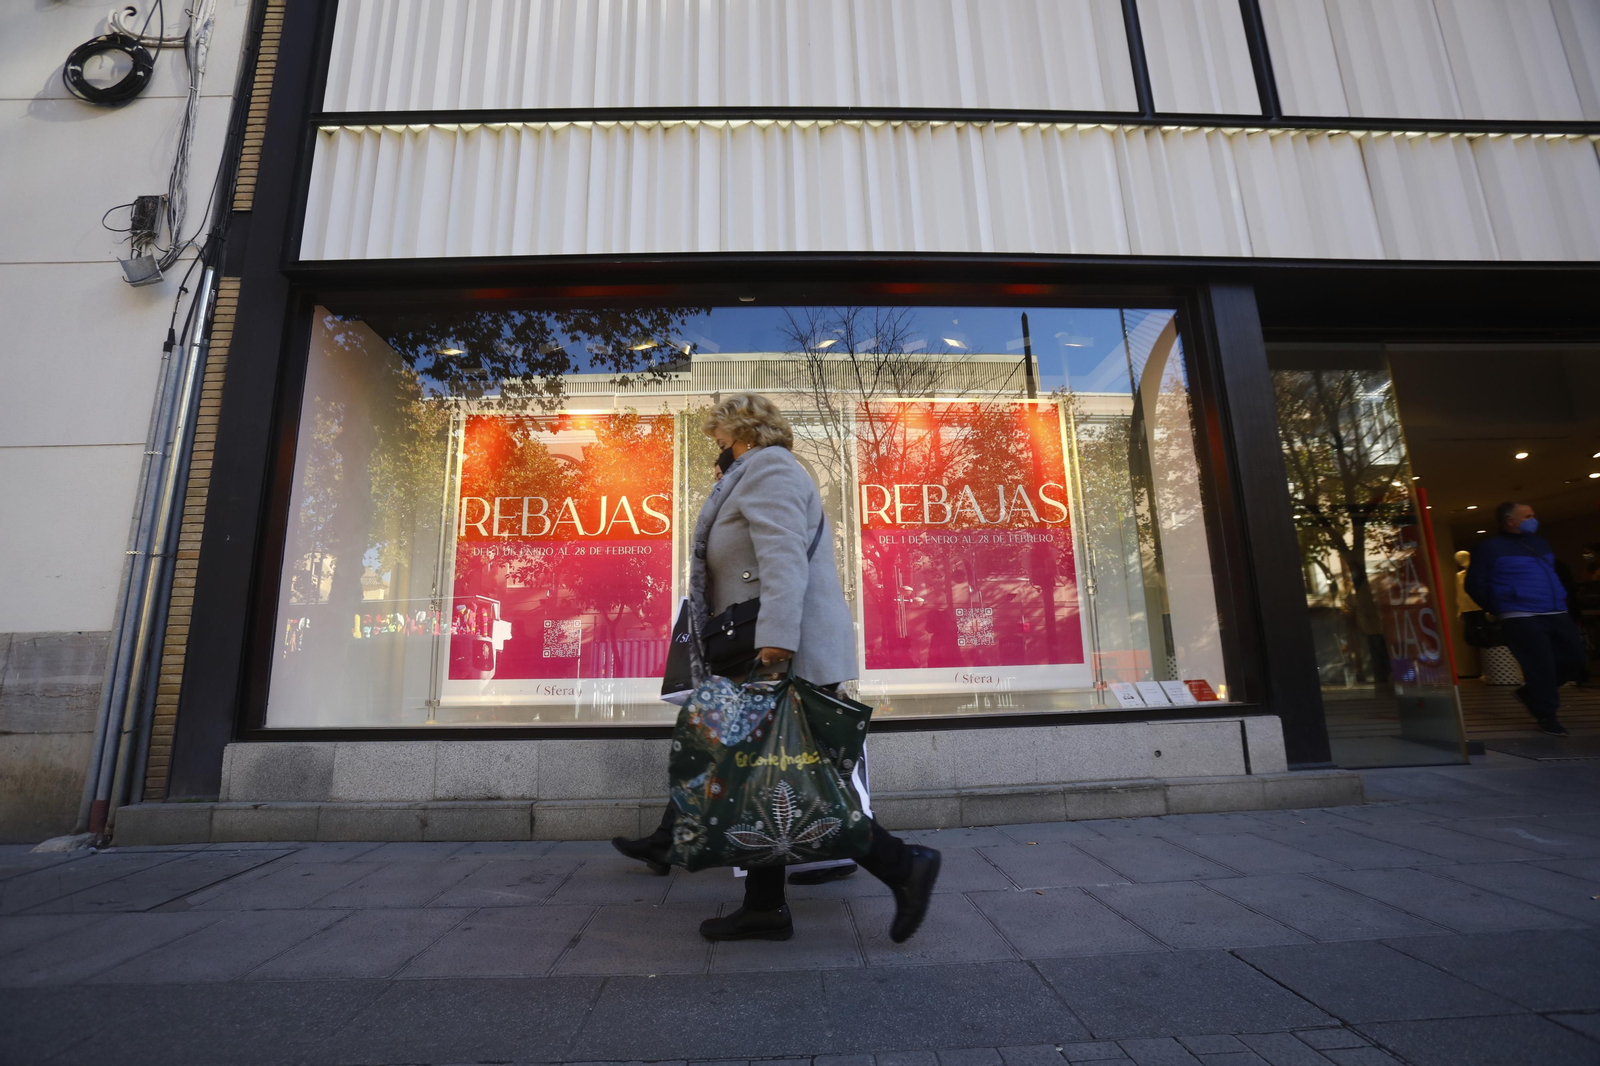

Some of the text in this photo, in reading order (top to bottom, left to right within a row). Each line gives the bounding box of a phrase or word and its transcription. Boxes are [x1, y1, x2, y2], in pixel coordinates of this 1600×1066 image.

[459, 494, 671, 537] REBAJAS
[861, 482, 1068, 525] REBAJAS
[558, 546, 571, 556] AL
[575, 546, 586, 556] 28
[590, 546, 603, 555] DE
[606, 545, 652, 555] FEBRERO
[879, 535, 898, 544] DEL
[908, 535, 921, 544] DE
[925, 535, 957, 544] ENERO
[962, 535, 975, 543] AL
[979, 535, 989, 543] 28
[993, 535, 1006, 543] DE
[1009, 534, 1054, 543] FEBRERO
[1391, 607, 1441, 660] JAS
[735, 751, 748, 767] El
[749, 751, 779, 767] Corte
